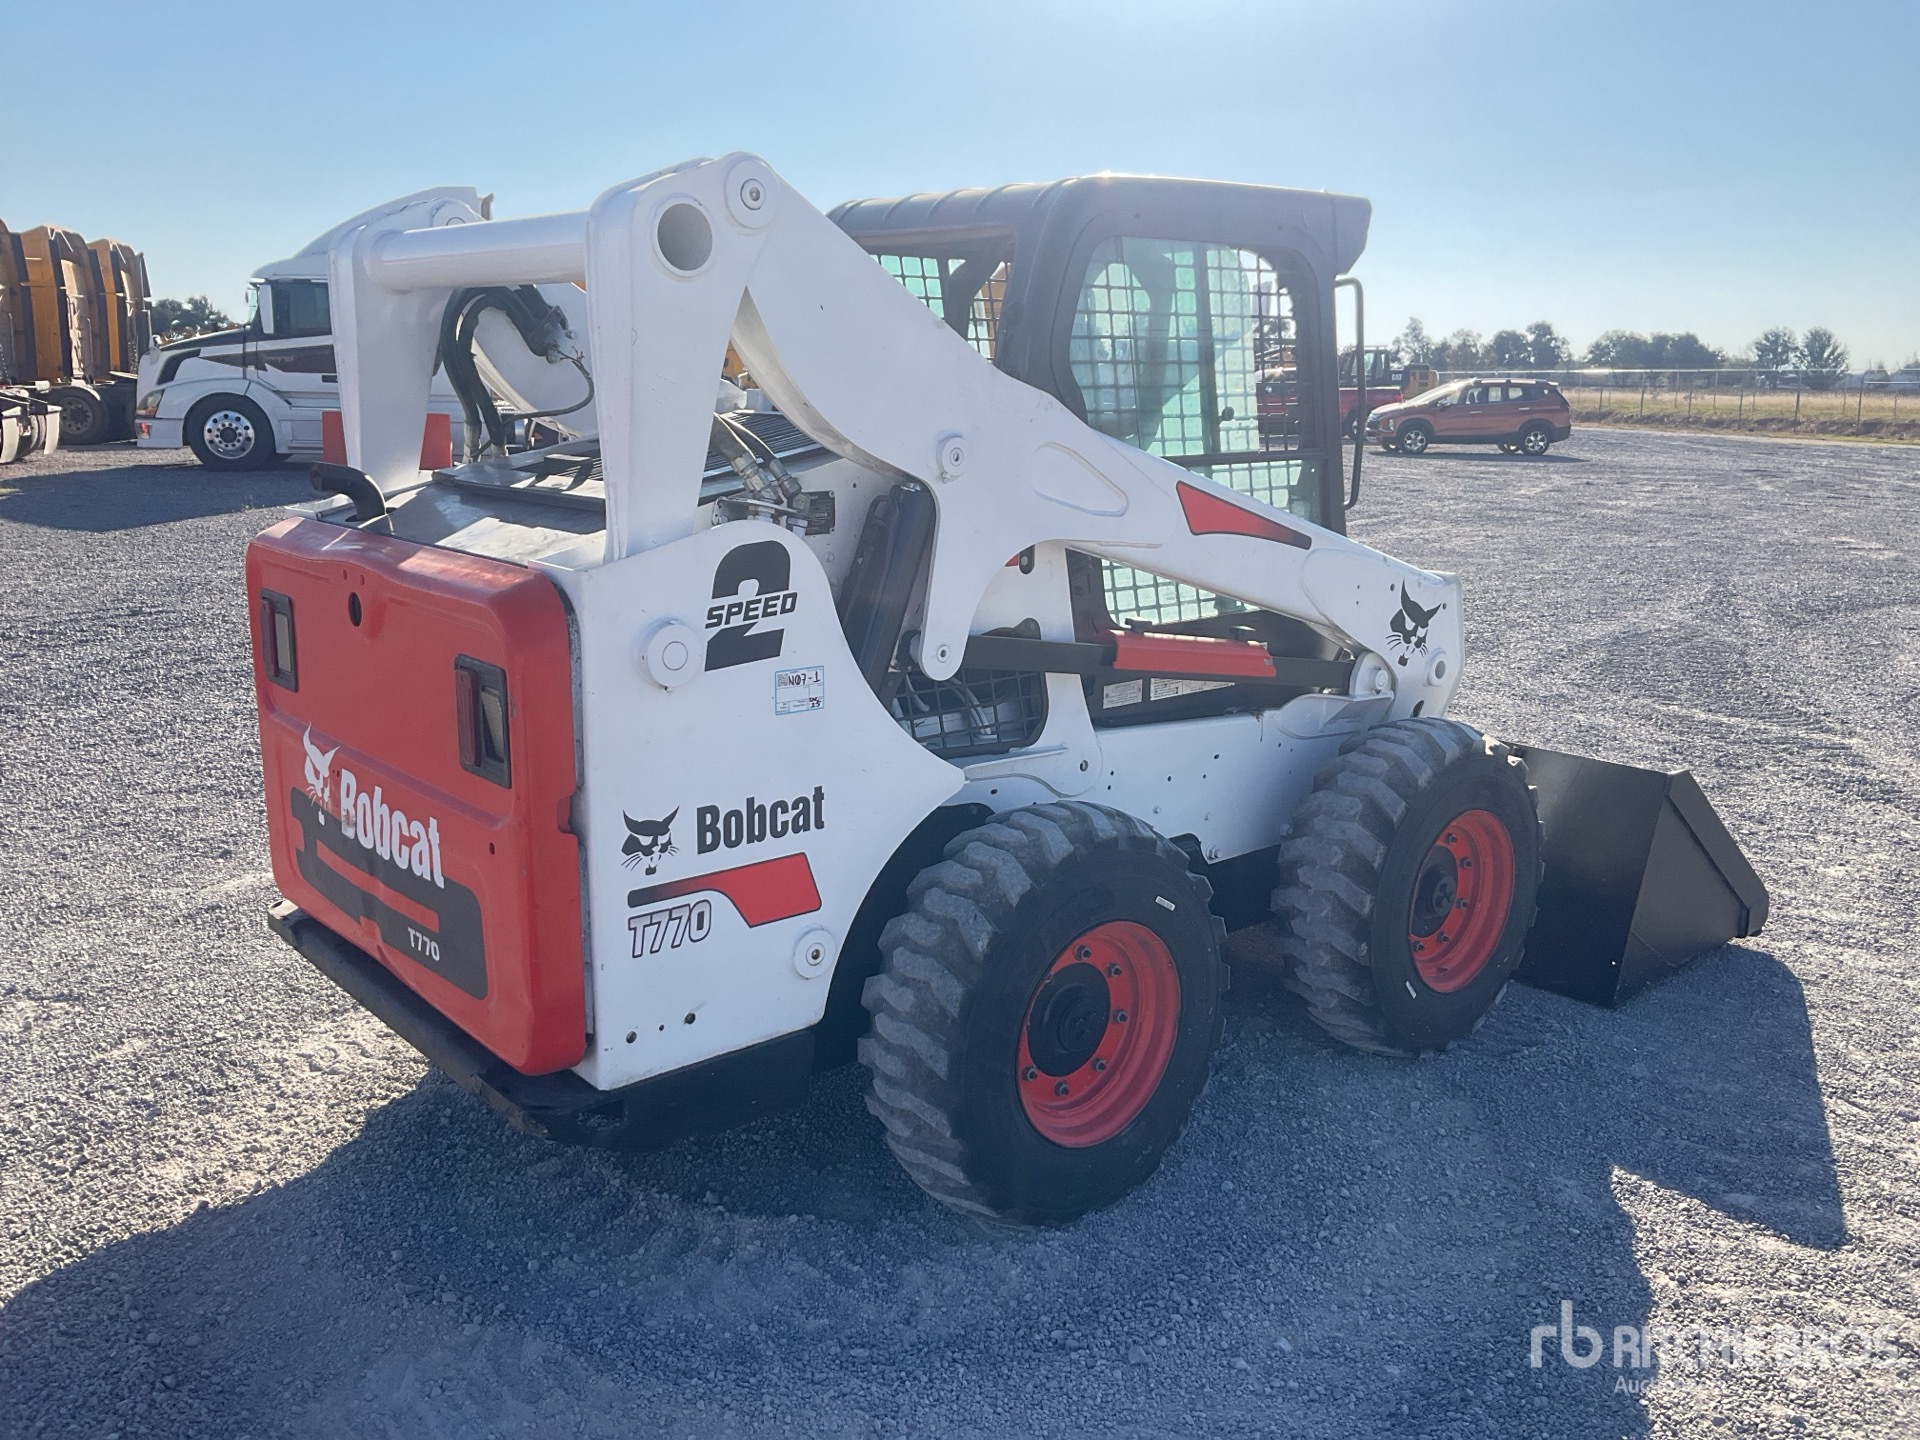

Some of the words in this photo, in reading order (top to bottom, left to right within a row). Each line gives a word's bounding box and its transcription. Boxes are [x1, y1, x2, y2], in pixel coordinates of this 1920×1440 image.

[704, 540, 791, 672] 2
[705, 592, 798, 629] SPEED
[340, 768, 445, 890] Bobcat
[696, 786, 825, 855] Bobcat
[406, 926, 440, 963] T770
[628, 899, 712, 959] T770
